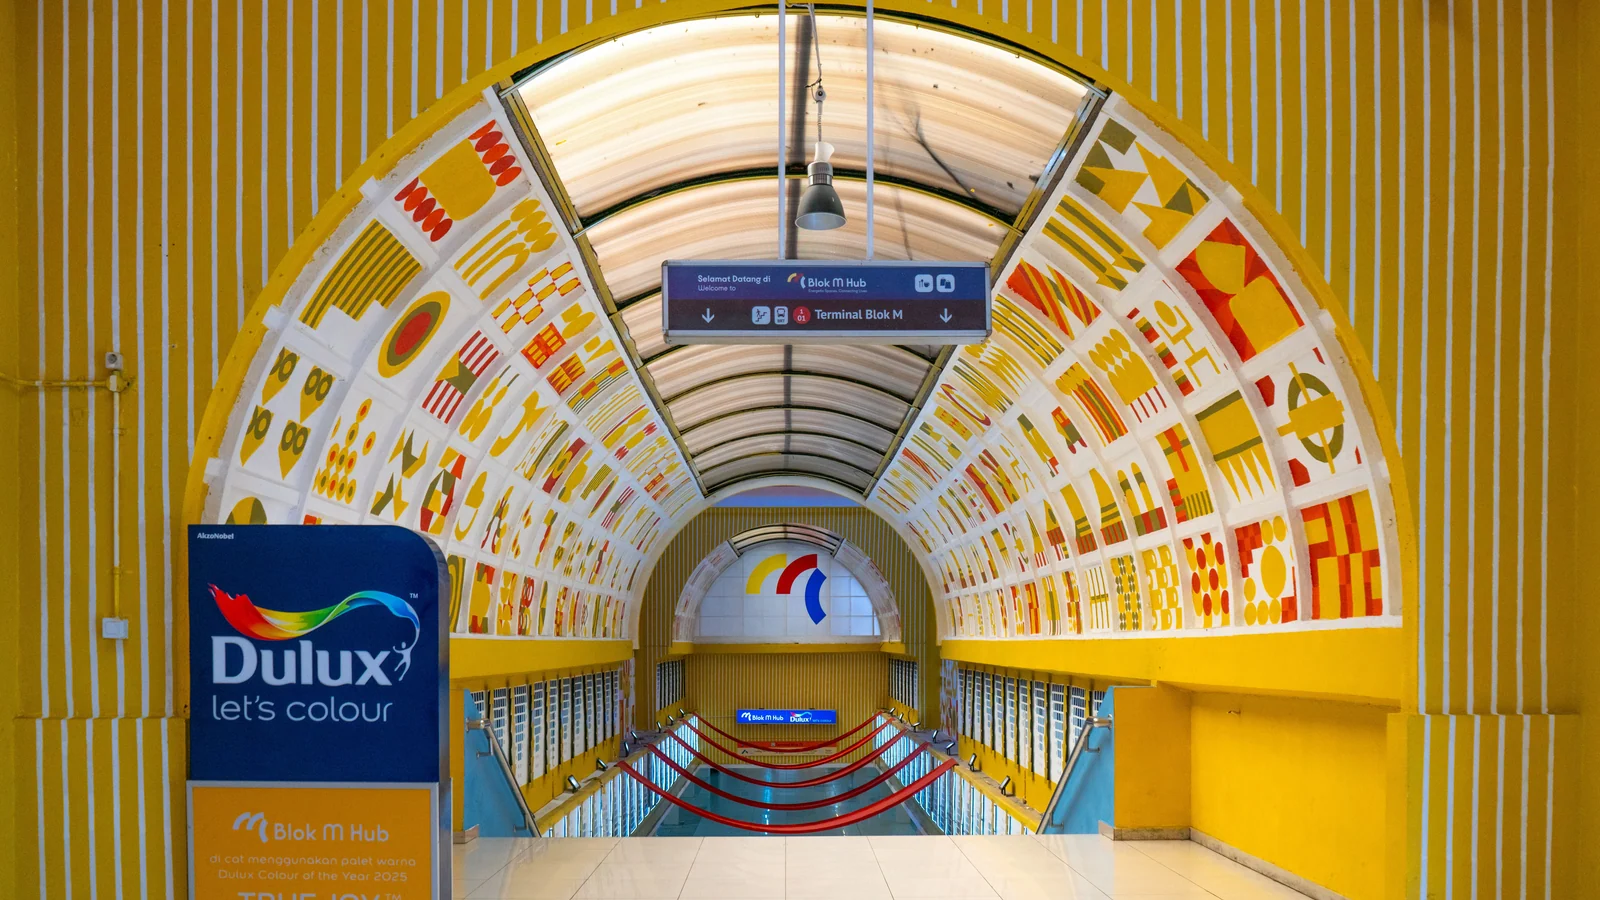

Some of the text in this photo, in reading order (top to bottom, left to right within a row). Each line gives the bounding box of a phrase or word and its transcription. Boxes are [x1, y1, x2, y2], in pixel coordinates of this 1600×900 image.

[697, 275, 771, 285] Selamat Datang di
[808, 277, 867, 288] Blok M Hub
[815, 309, 903, 320] Terminal Blok M
[197, 532, 235, 540] AkzoNobel
[211, 635, 393, 686] Dulux
[212, 695, 393, 722] let's colour
[274, 823, 389, 842] Blok M Hub
[209, 855, 416, 867] di cat menggunakan palet warna
[218, 869, 408, 882] Dulux Colour of the Year 2025
